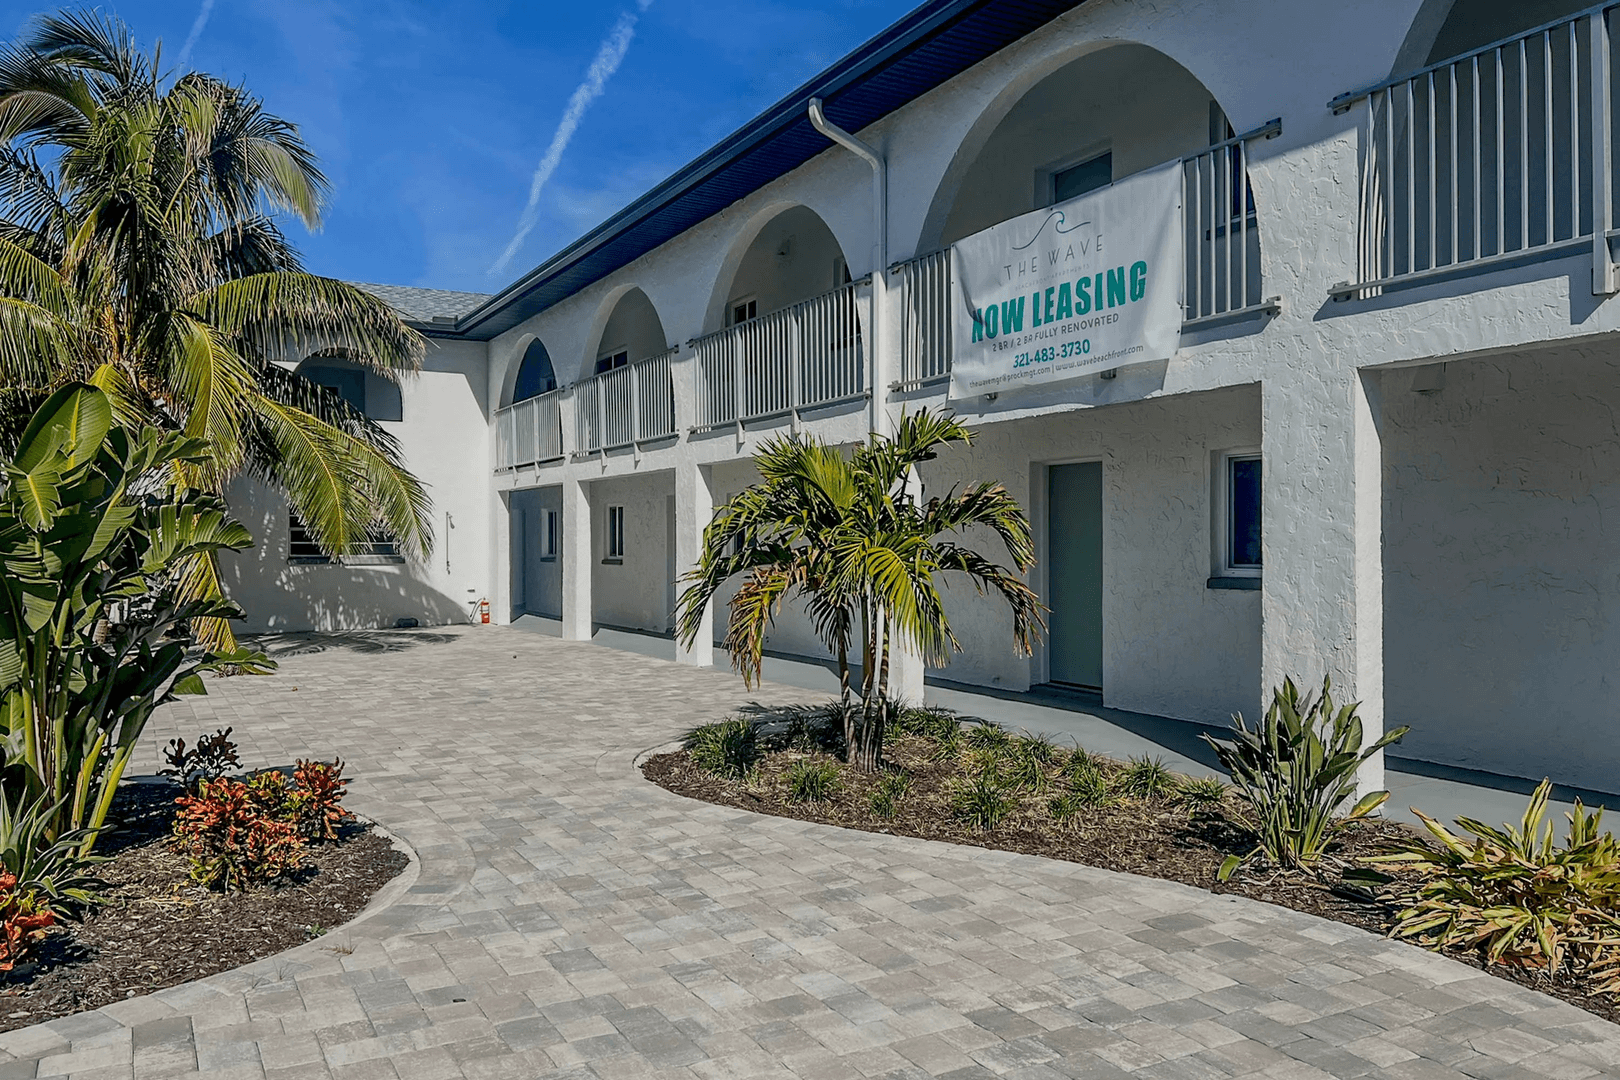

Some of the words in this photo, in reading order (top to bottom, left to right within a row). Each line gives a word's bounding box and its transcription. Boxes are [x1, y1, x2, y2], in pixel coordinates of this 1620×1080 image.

[1004, 256, 1038, 280] THE
[1048, 234, 1103, 264] WAVE
[971, 296, 1024, 343] NOW
[1032, 260, 1147, 328] LEASING
[993, 344, 997, 352] 2
[999, 341, 1008, 350] BR
[1017, 337, 1021, 346] 2
[1024, 333, 1033, 344] BA
[1035, 327, 1058, 342] FULLY
[1061, 313, 1119, 333] RENOVATED
[1013, 339, 1090, 368] 321-483-3730
[969, 367, 1050, 388] thewavemgr@prockmgt.com
[1056, 344, 1144, 371] www.wavebeachfront.com
